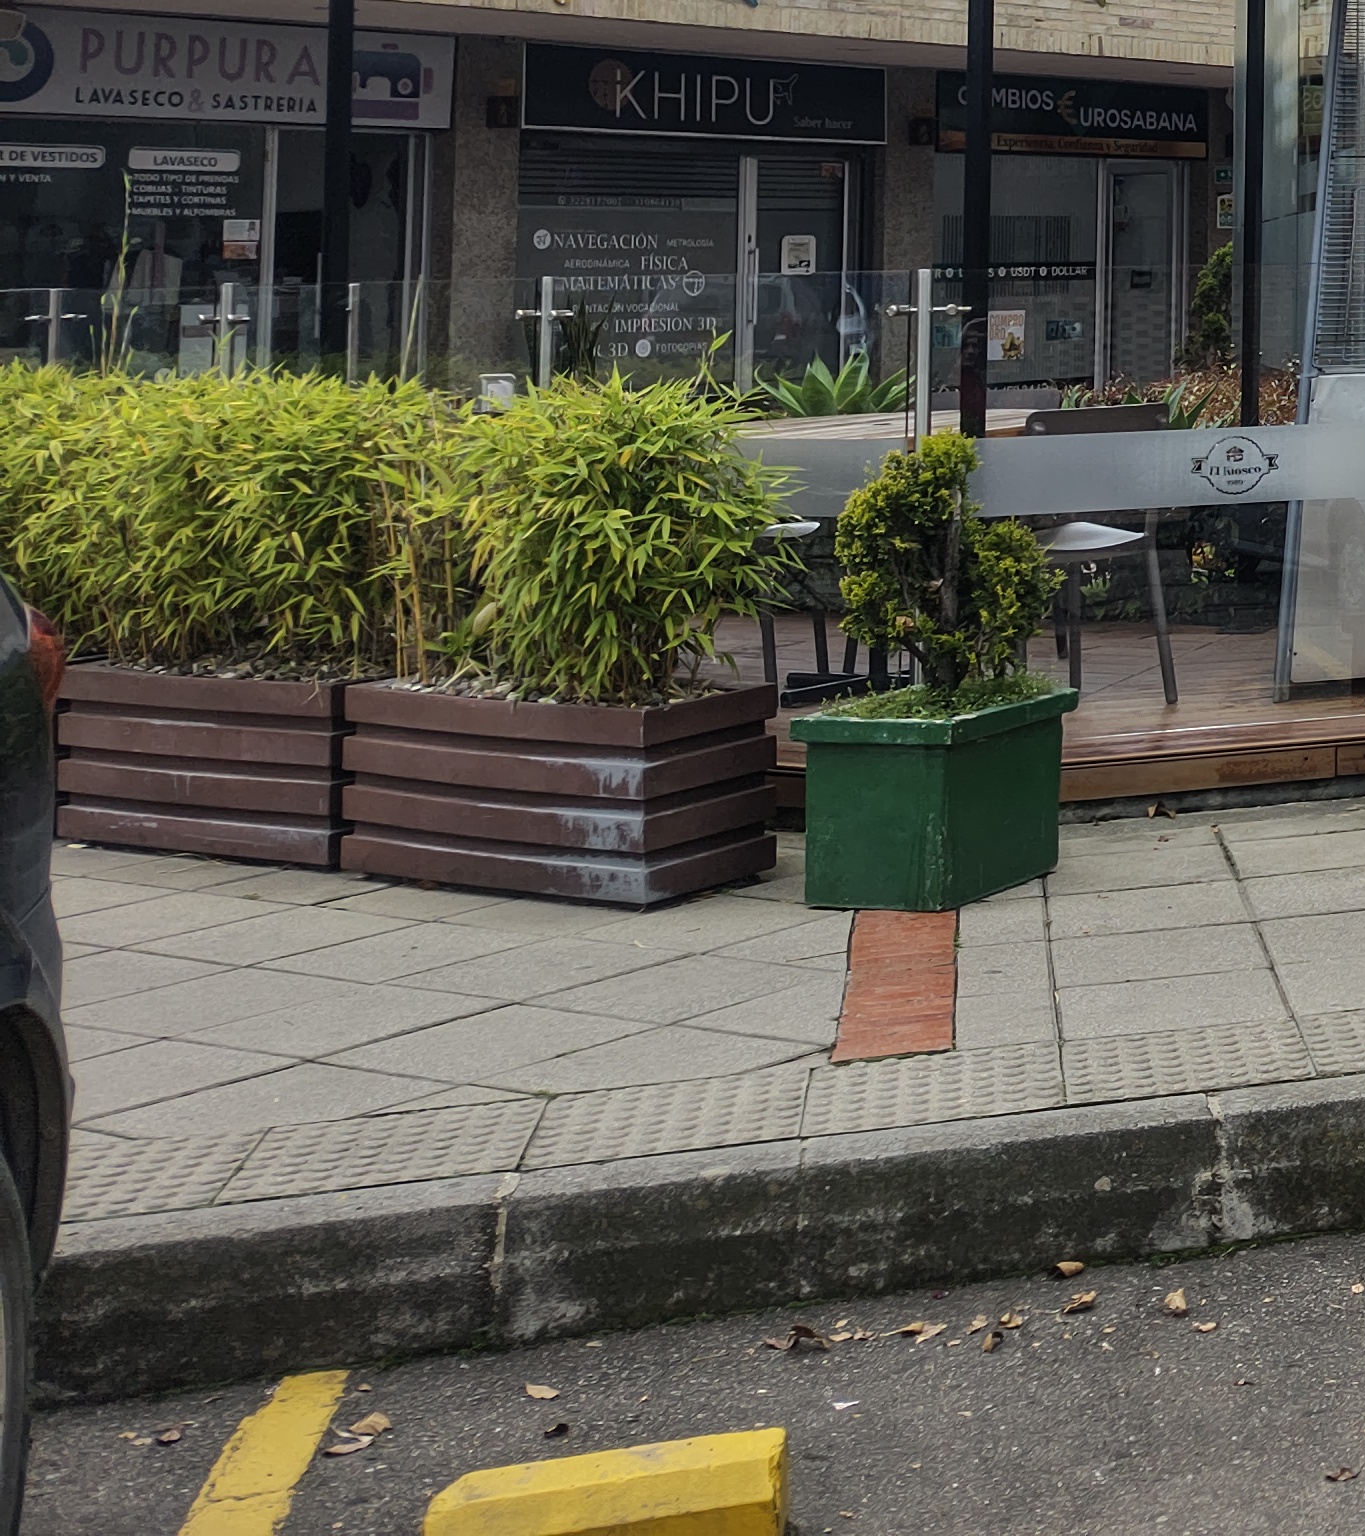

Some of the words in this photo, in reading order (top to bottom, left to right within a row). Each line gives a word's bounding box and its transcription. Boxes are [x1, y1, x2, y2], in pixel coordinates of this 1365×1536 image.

[79, 27, 321, 88] PURPURA
[74, 87, 185, 109] LAVASECO
[188, 87, 205, 114] &
[210, 93, 318, 115] SASTRERIA
[614, 69, 775, 126] KHIPU
[957, 85, 1054, 112] CMBIOS
[793, 115, 823, 129] Saber
[825, 116, 854, 130] hacer
[9, 150, 27, 162] DE
[31, 151, 98, 163] VESTIDOS
[153, 154, 218, 167] LAVASECO
[8, 174, 16, 182] Y
[18, 174, 52, 182] VENTA
[162, 174, 182, 182] TIPO
[185, 174, 196, 183] DE
[181, 185, 228, 194] TINTURAS
[133, 195, 171, 204] TAPETES
[181, 196, 227, 205] CORTINAS
[132, 207, 173, 216] MUEBLES
[175, 208, 181, 216] Y
[183, 208, 236, 217] ALFOMBRAS
[552, 231, 658, 250] NAVEGACIÓN
[666, 237, 714, 248] METROLOGÍA
[563, 256, 630, 269] AERODINÁMICA
[639, 251, 689, 271] FÍSICA
[1011, 266, 1036, 277] USDT
[1051, 266, 1088, 276] DOLLAR
[562, 274, 677, 291] MATEMÁTICAS
[615, 317, 692, 334] IMPRESION
[697, 316, 717, 331] 3D
[989, 313, 1025, 327] COMPRO
[609, 342, 629, 357] 3D
[1223, 465, 1262, 476] Kiosco
